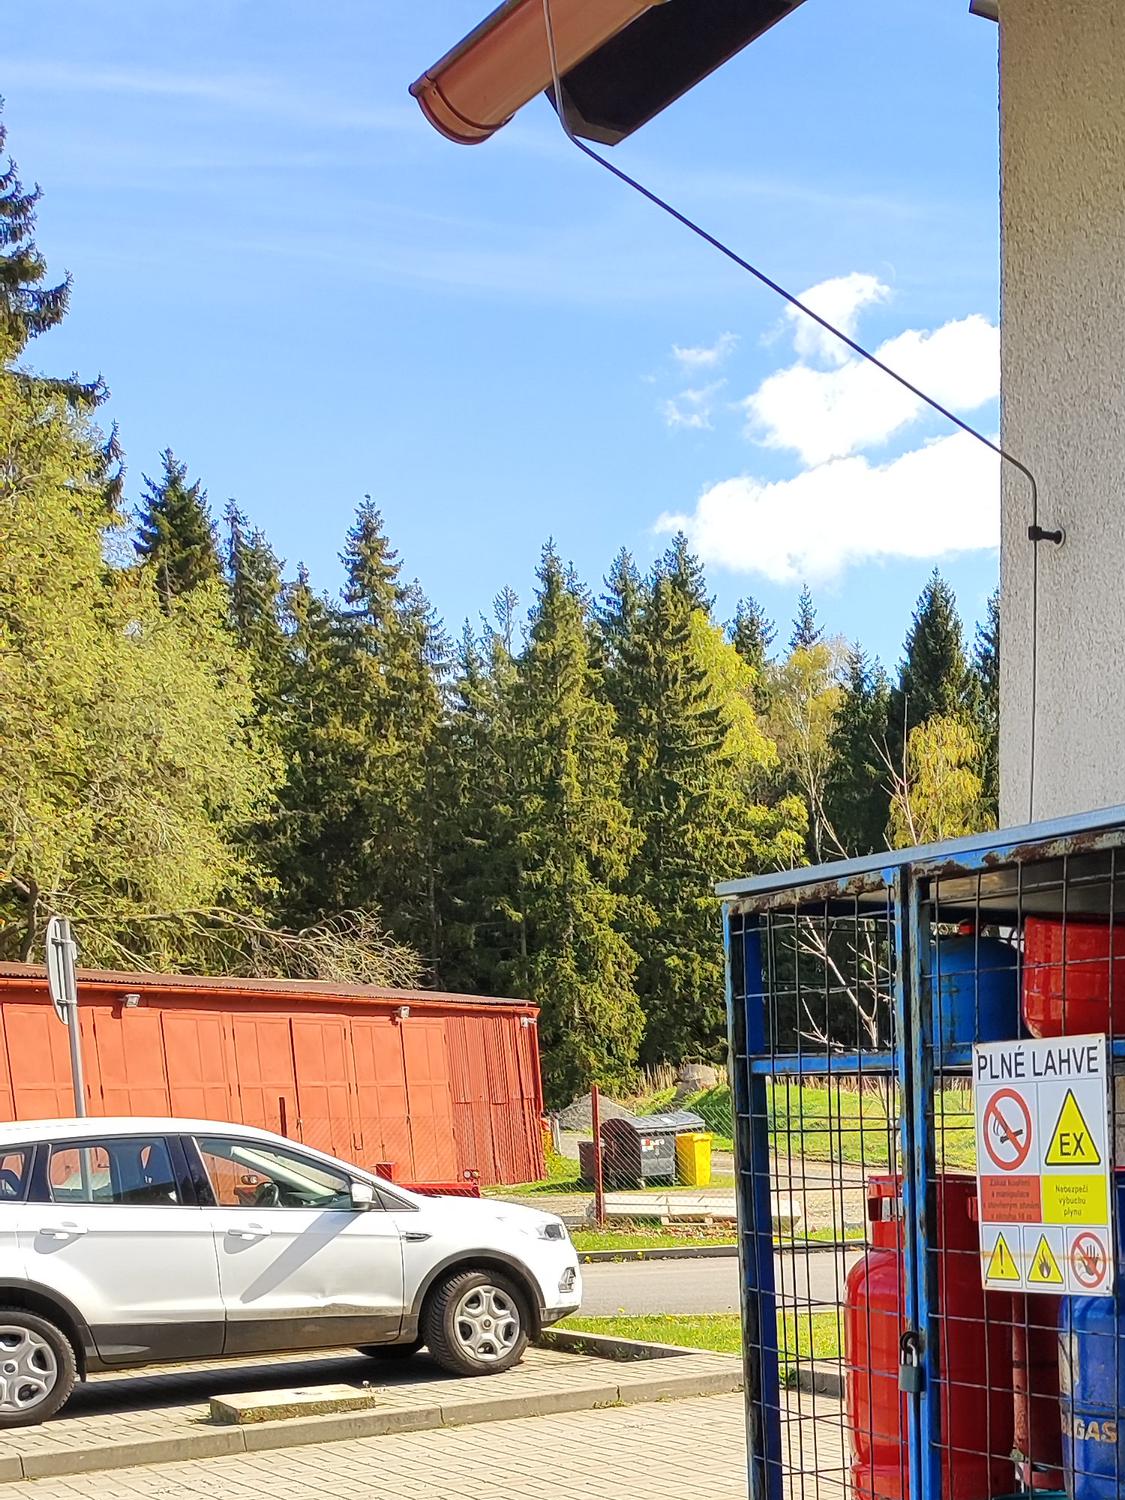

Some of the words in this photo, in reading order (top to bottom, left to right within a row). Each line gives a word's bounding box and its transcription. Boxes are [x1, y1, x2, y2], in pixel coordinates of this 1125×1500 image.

[978, 1045, 1026, 1080] PLNÉ
[1033, 1047, 1098, 1077] LAHVE
[1060, 1133, 1085, 1156] EX
